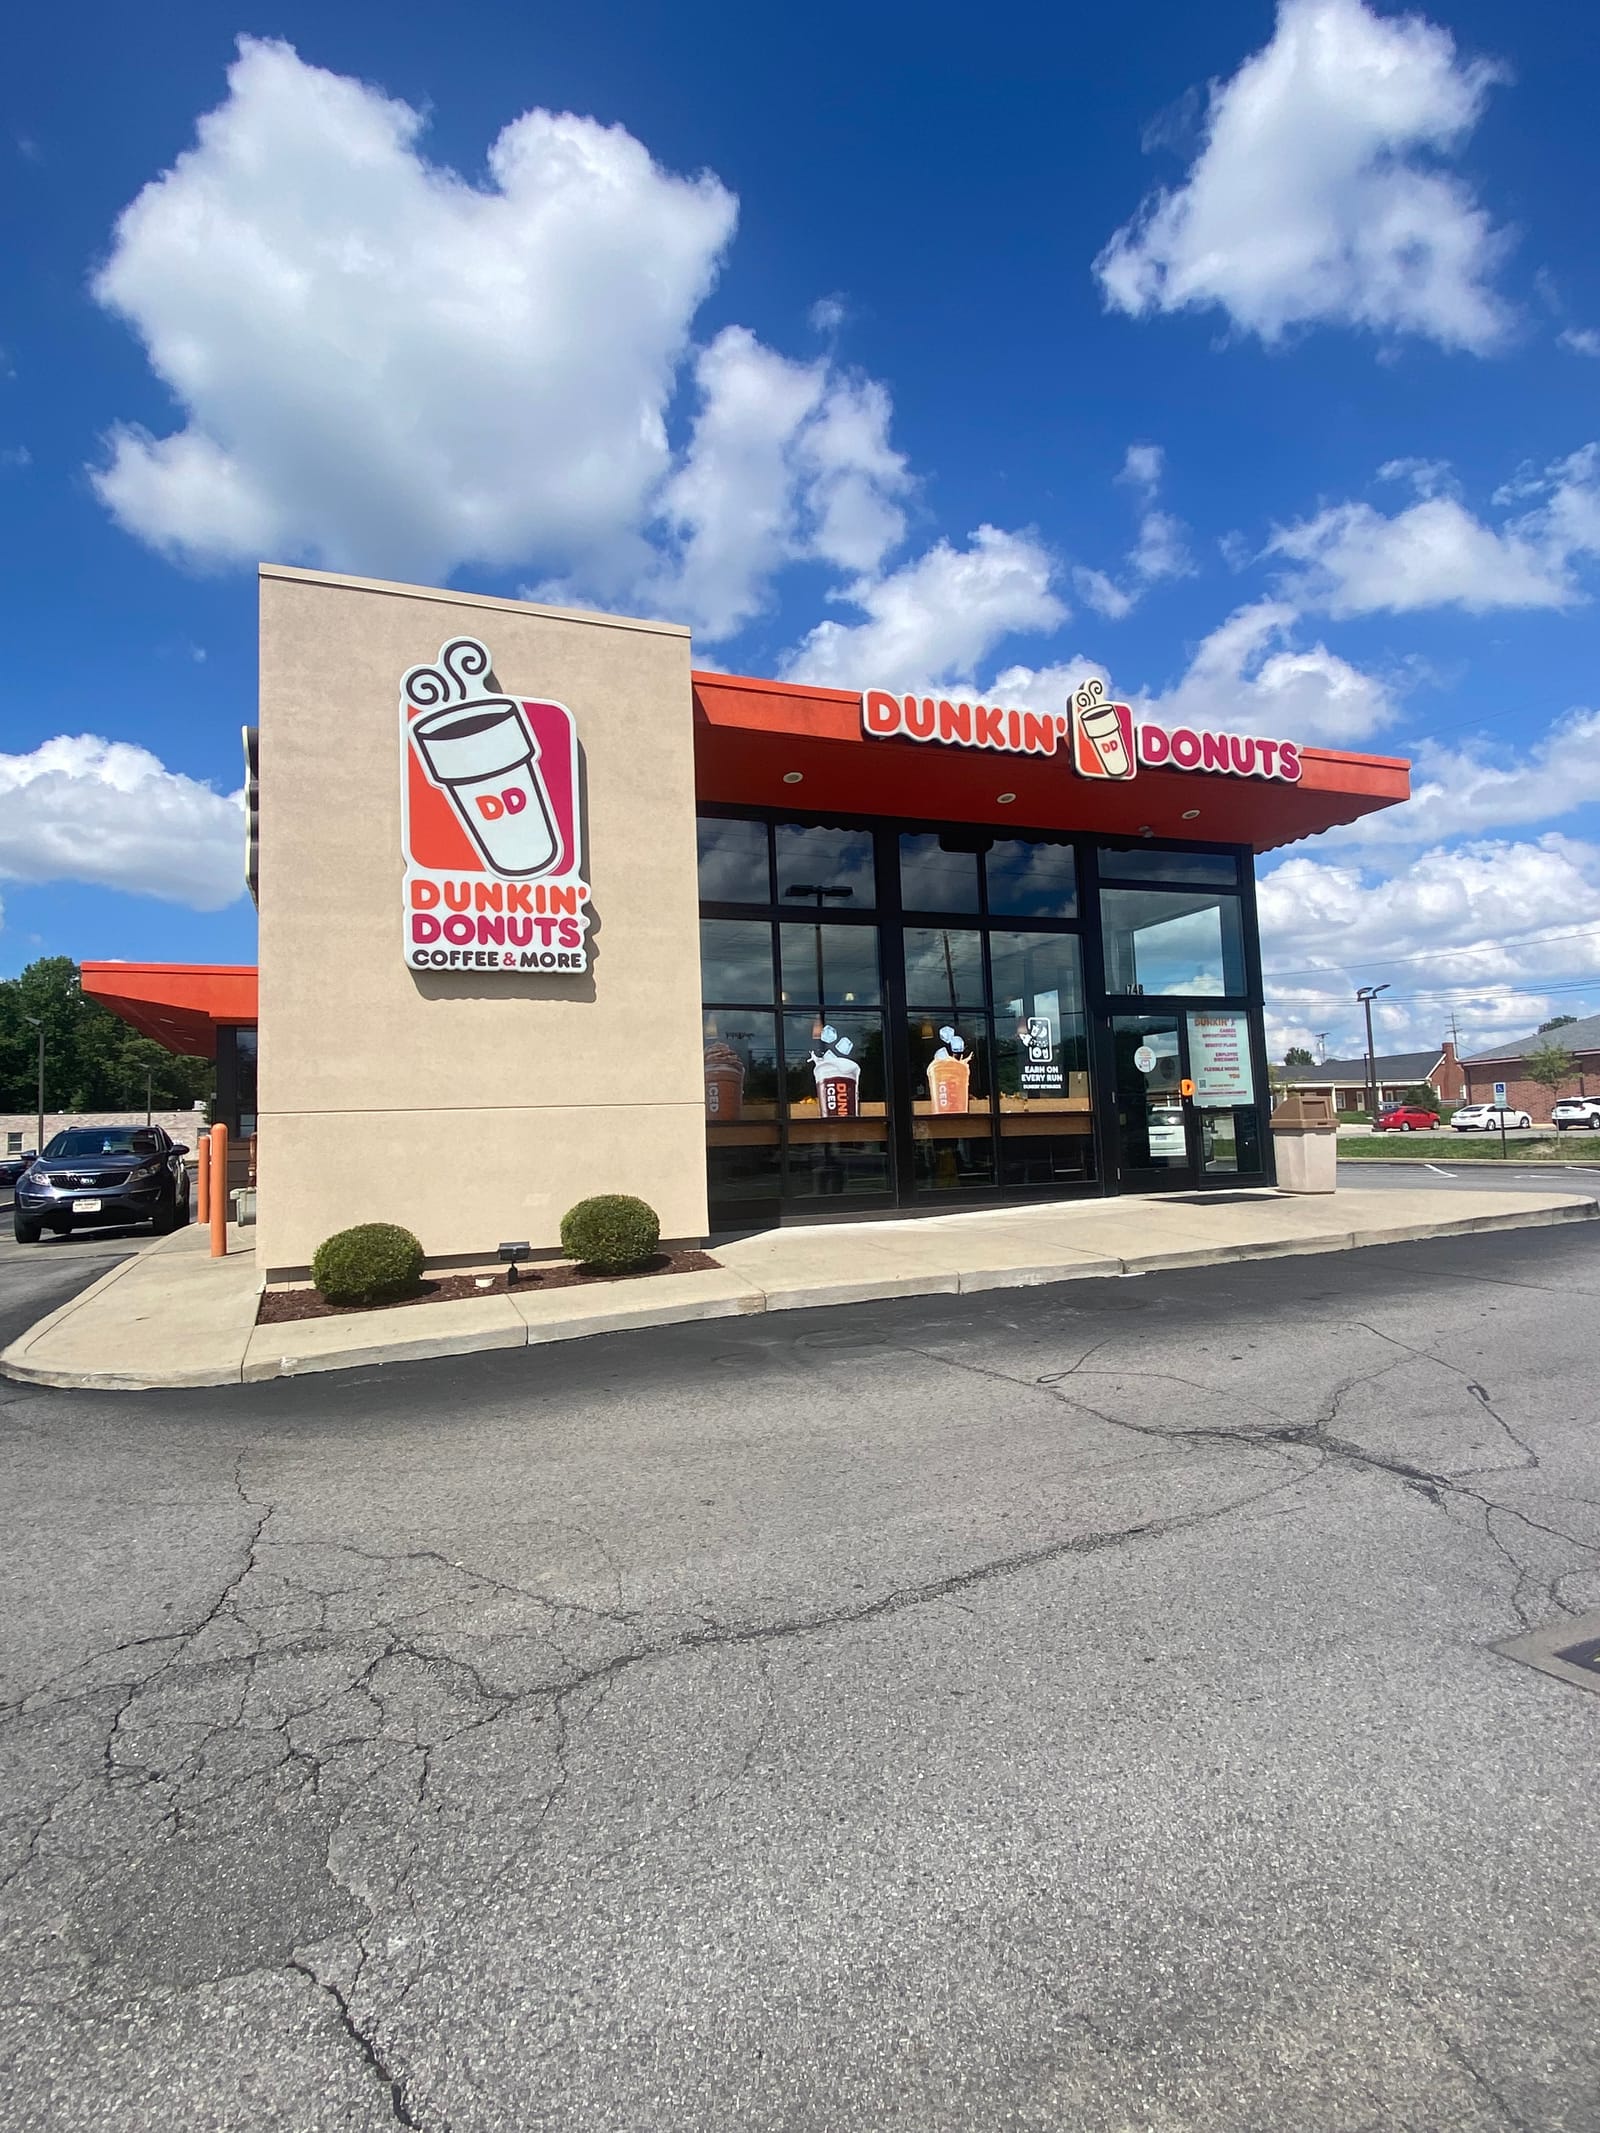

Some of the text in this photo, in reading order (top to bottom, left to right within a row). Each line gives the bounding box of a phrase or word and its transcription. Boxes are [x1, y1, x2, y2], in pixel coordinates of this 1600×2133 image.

[867, 691, 1300, 779] DUNKIN' DONUTS
[1101, 740, 1118, 754] DD
[475, 787, 526, 821] DD
[411, 879, 587, 915] DUNKIN'
[412, 913, 581, 948] DONUTS
[412, 949, 582, 968] COFFEE & MORE
[709, 1082, 719, 1112] ICED
[827, 1083, 836, 1110] ICED
[938, 1081, 947, 1106] ICED
